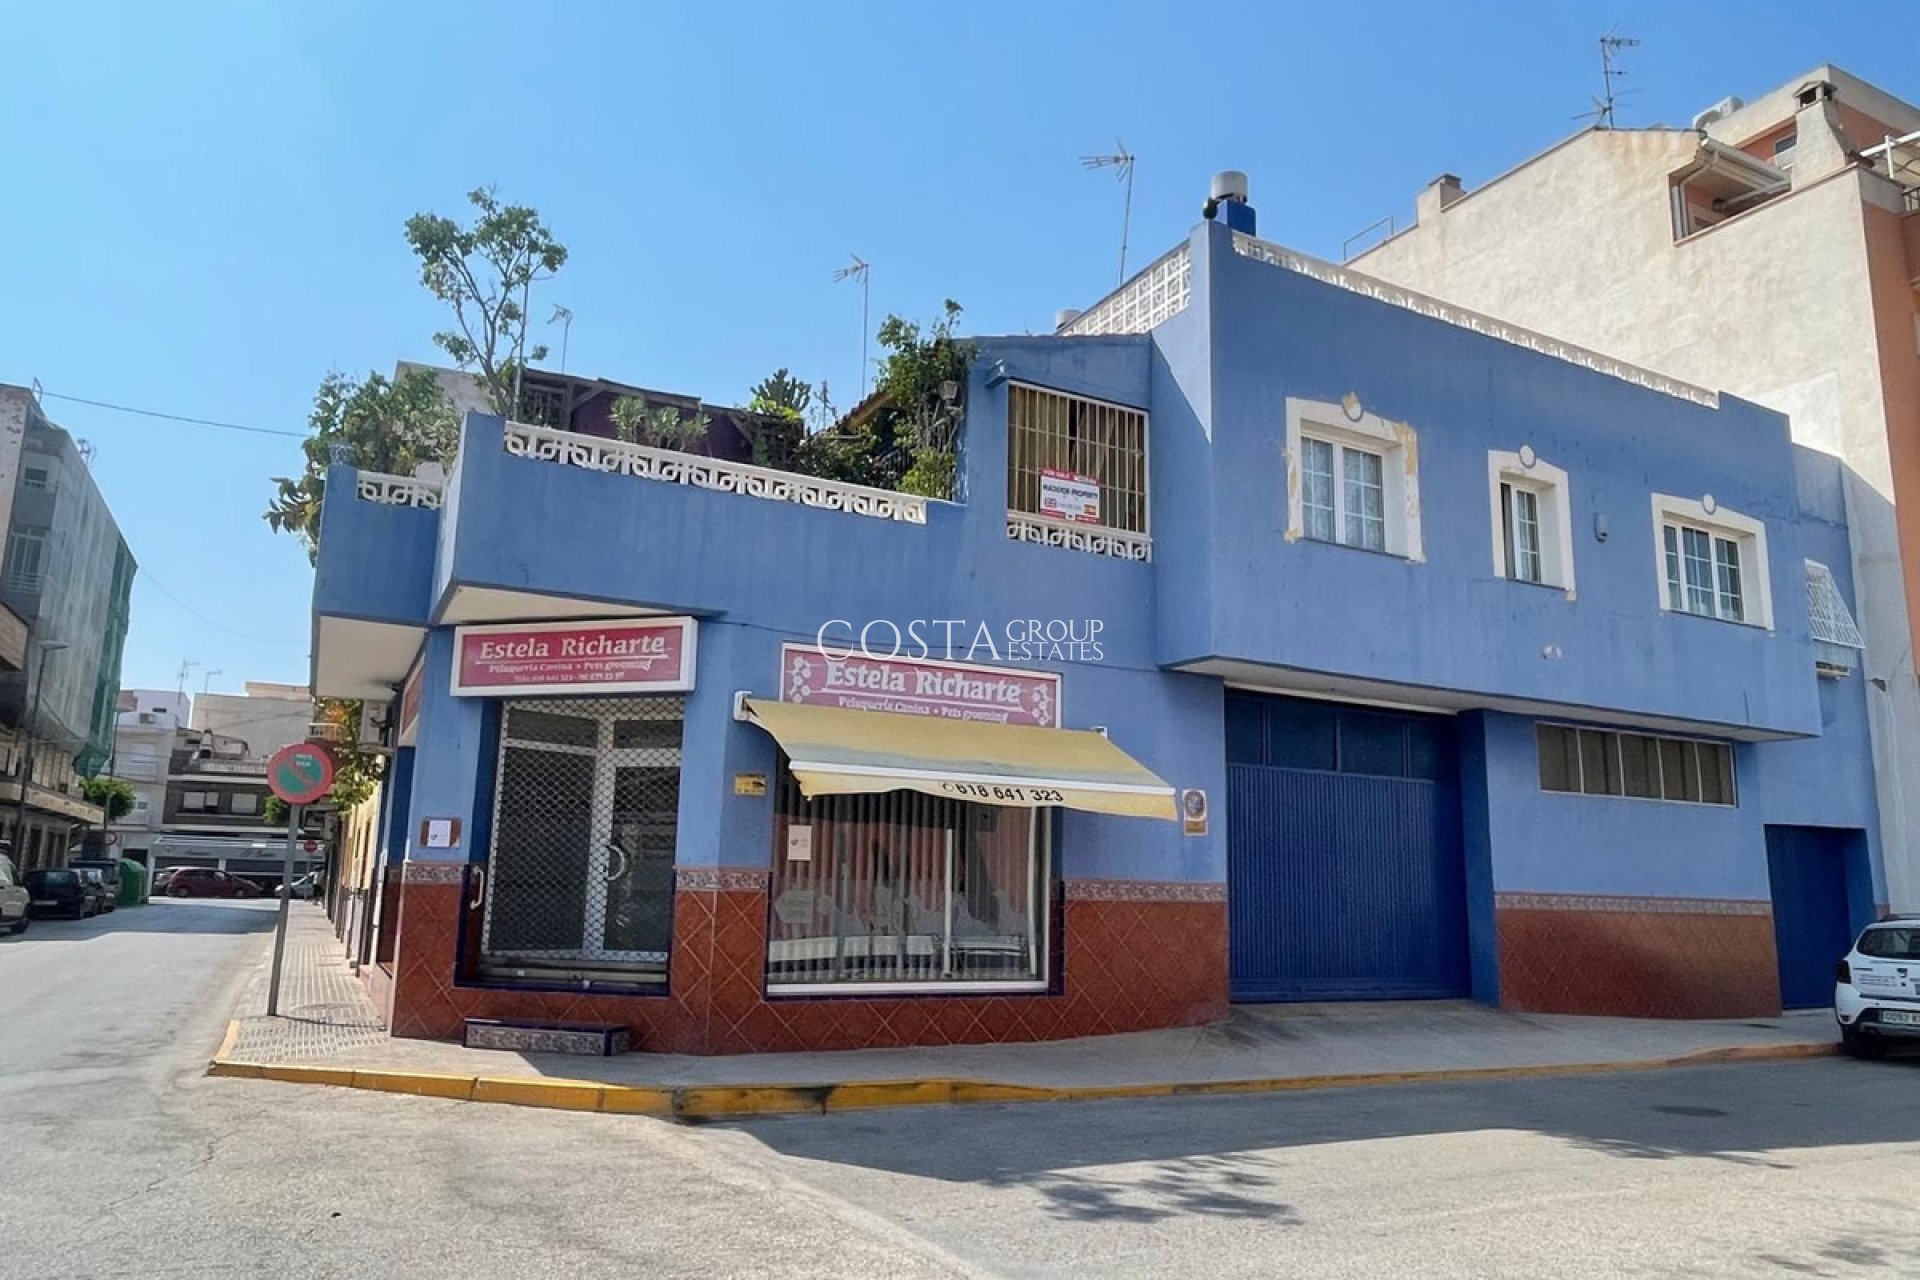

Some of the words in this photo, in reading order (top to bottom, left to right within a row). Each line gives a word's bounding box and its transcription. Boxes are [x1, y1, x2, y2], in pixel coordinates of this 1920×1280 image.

[480, 637, 549, 660] Estela
[561, 634, 665, 657] Richarte
[825, 661, 906, 692] Estela
[915, 668, 1021, 703] Richarte
[955, 783, 989, 798] 618
[993, 786, 1024, 801] 641
[1029, 789, 1064, 802] 323
